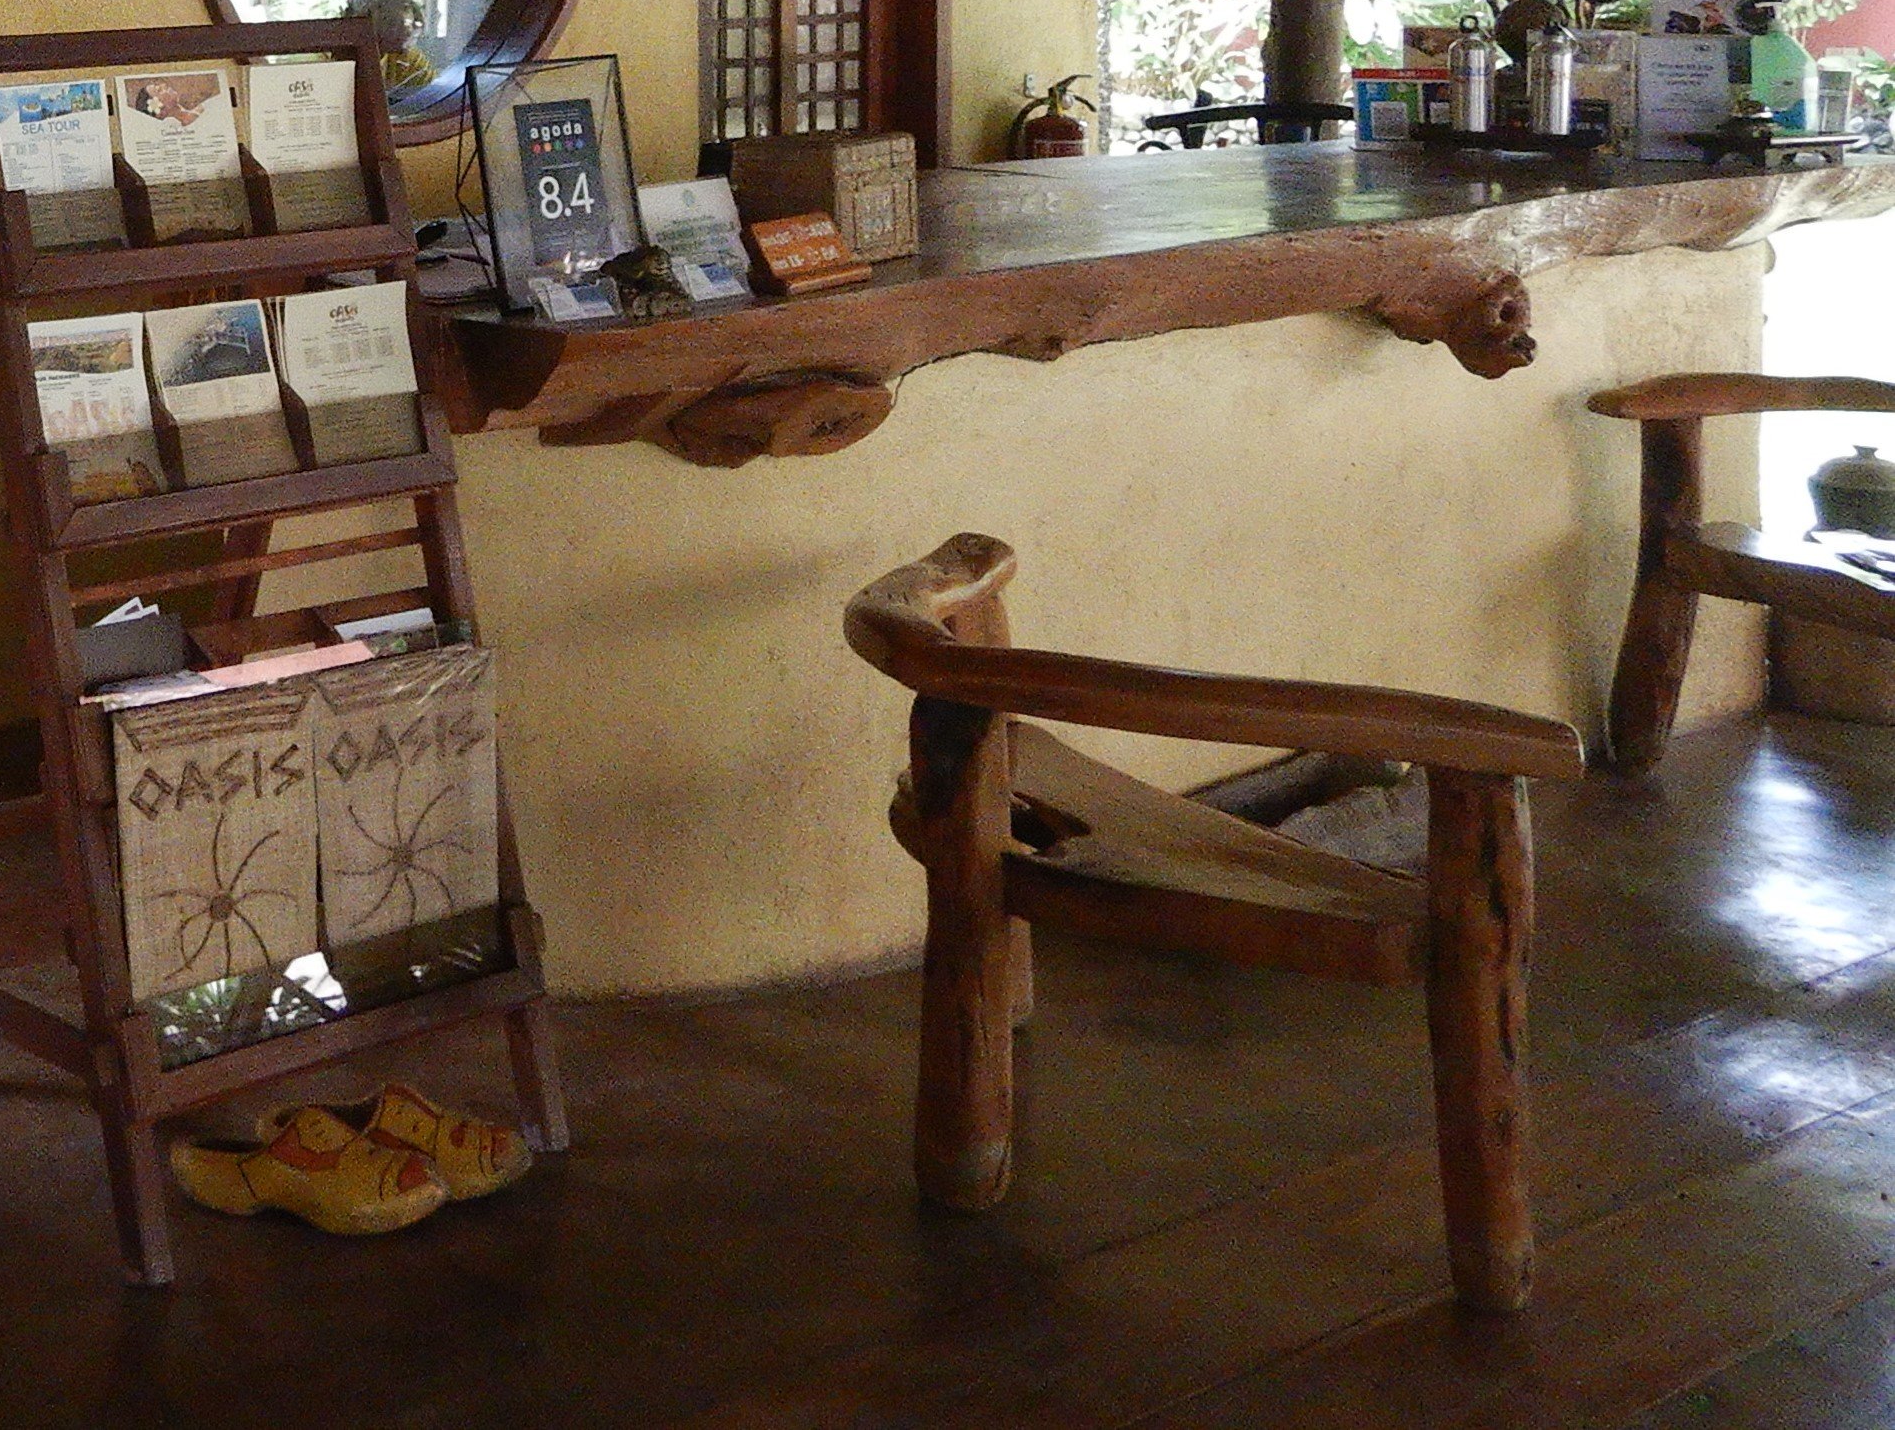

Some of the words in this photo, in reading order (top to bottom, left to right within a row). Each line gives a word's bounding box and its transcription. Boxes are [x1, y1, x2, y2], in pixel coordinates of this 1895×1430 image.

[21, 122, 44, 136] SEA
[49, 119, 81, 133] TOUR
[530, 121, 583, 141] agoda
[538, 172, 595, 220] 8.4
[325, 709, 489, 784] OASIS
[129, 743, 306, 822] OASIS
